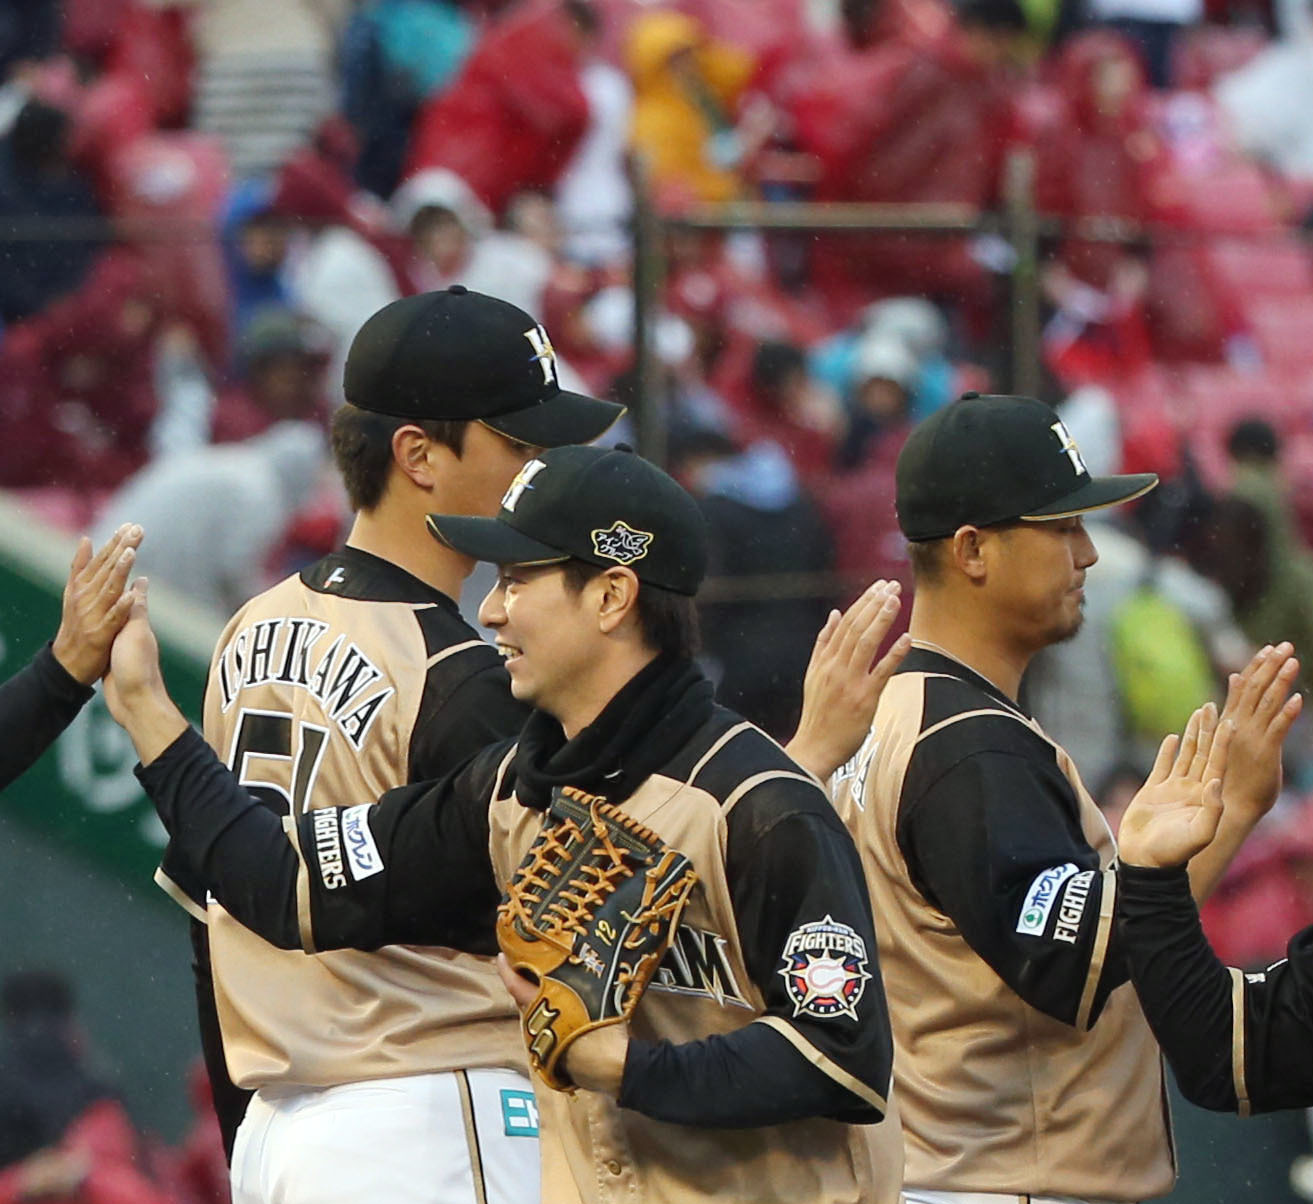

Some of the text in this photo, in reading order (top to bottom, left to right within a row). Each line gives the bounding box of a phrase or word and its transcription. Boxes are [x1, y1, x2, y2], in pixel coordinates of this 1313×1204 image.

[218, 617, 396, 752] ISHIKAWA
[312, 806, 347, 890] FIGHTERS
[594, 919, 618, 947] 12
[787, 932, 865, 961] FIGHTERS
